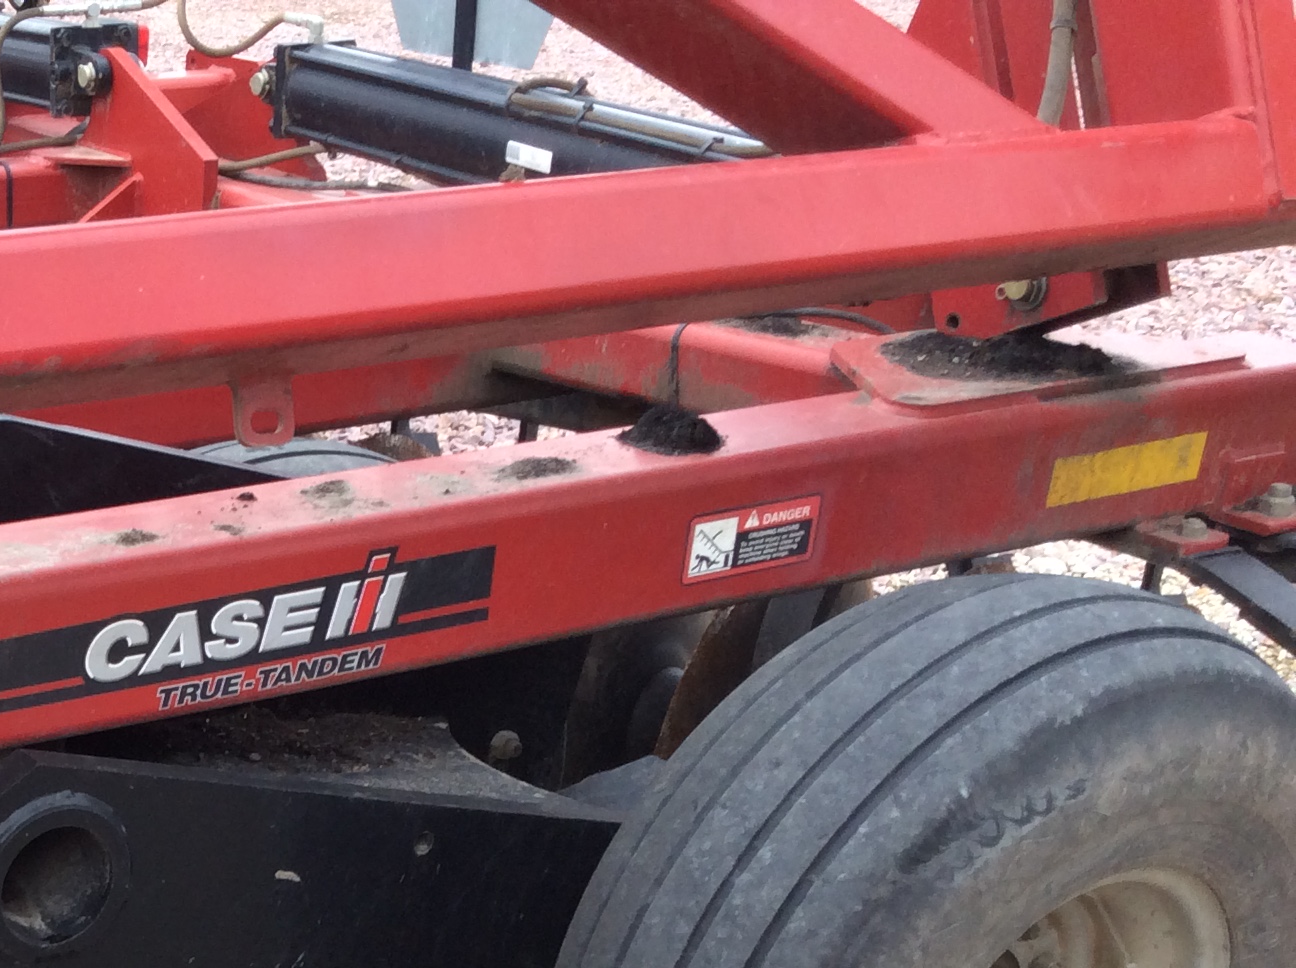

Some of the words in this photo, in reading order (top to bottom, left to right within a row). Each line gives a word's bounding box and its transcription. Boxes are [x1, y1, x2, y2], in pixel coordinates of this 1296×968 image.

[762, 505, 811, 525] DANGER
[85, 587, 326, 683] CASE
[157, 644, 386, 711] TRUE-TANDEM
